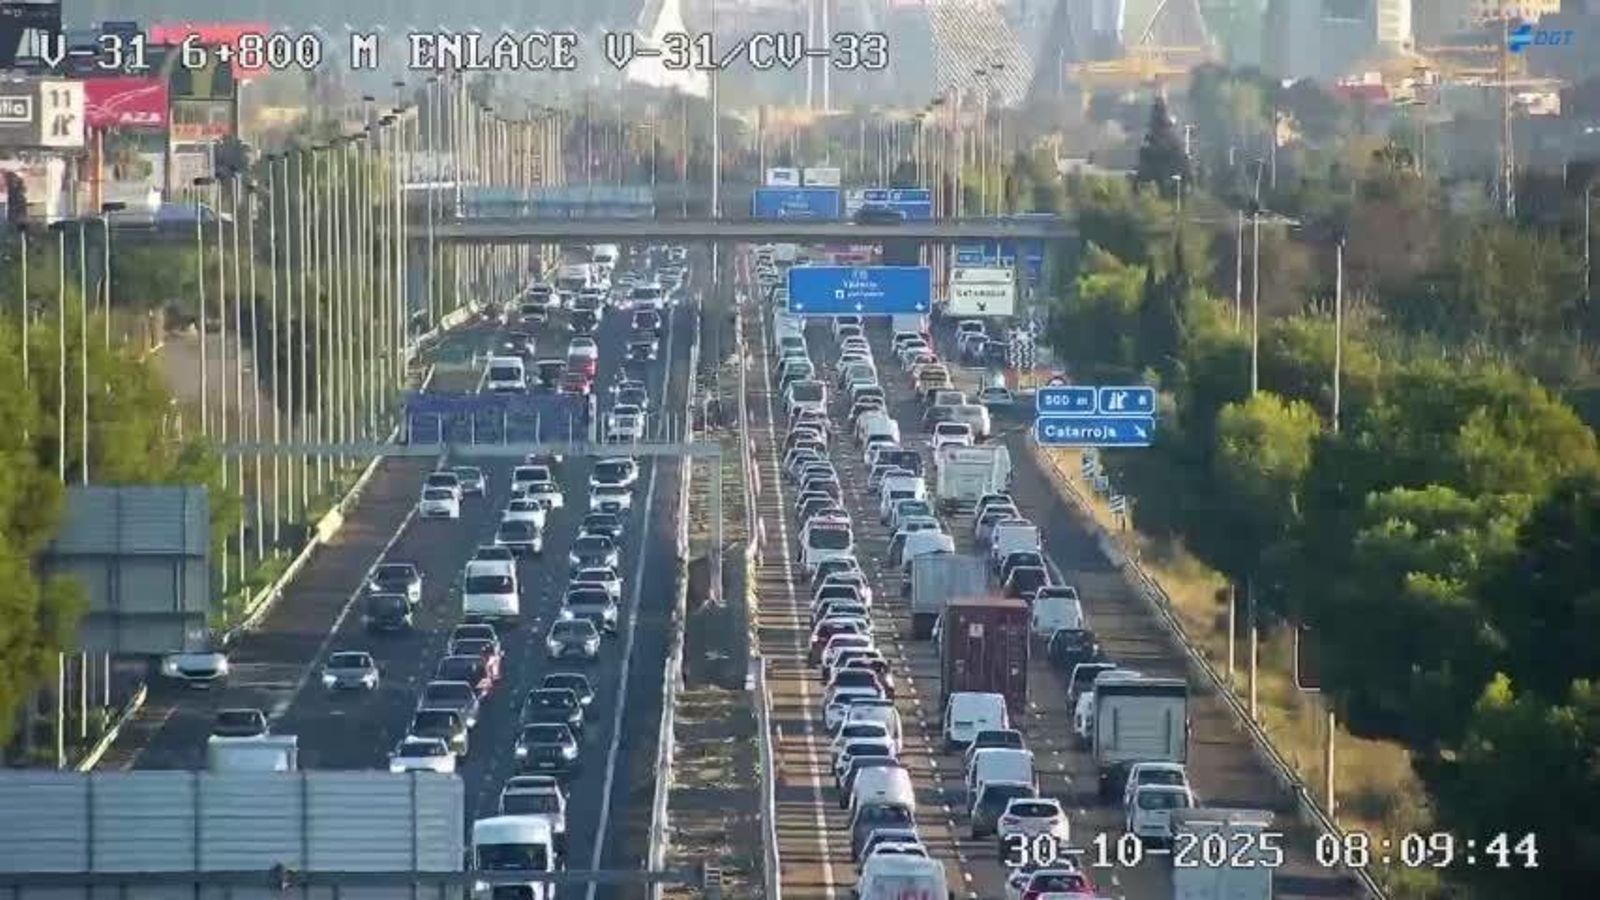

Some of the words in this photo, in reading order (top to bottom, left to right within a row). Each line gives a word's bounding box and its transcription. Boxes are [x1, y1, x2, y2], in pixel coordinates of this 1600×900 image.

[1045, 394, 1070, 406] 500
[1076, 397, 1089, 406] m
[1044, 424, 1117, 440] Catarroja
